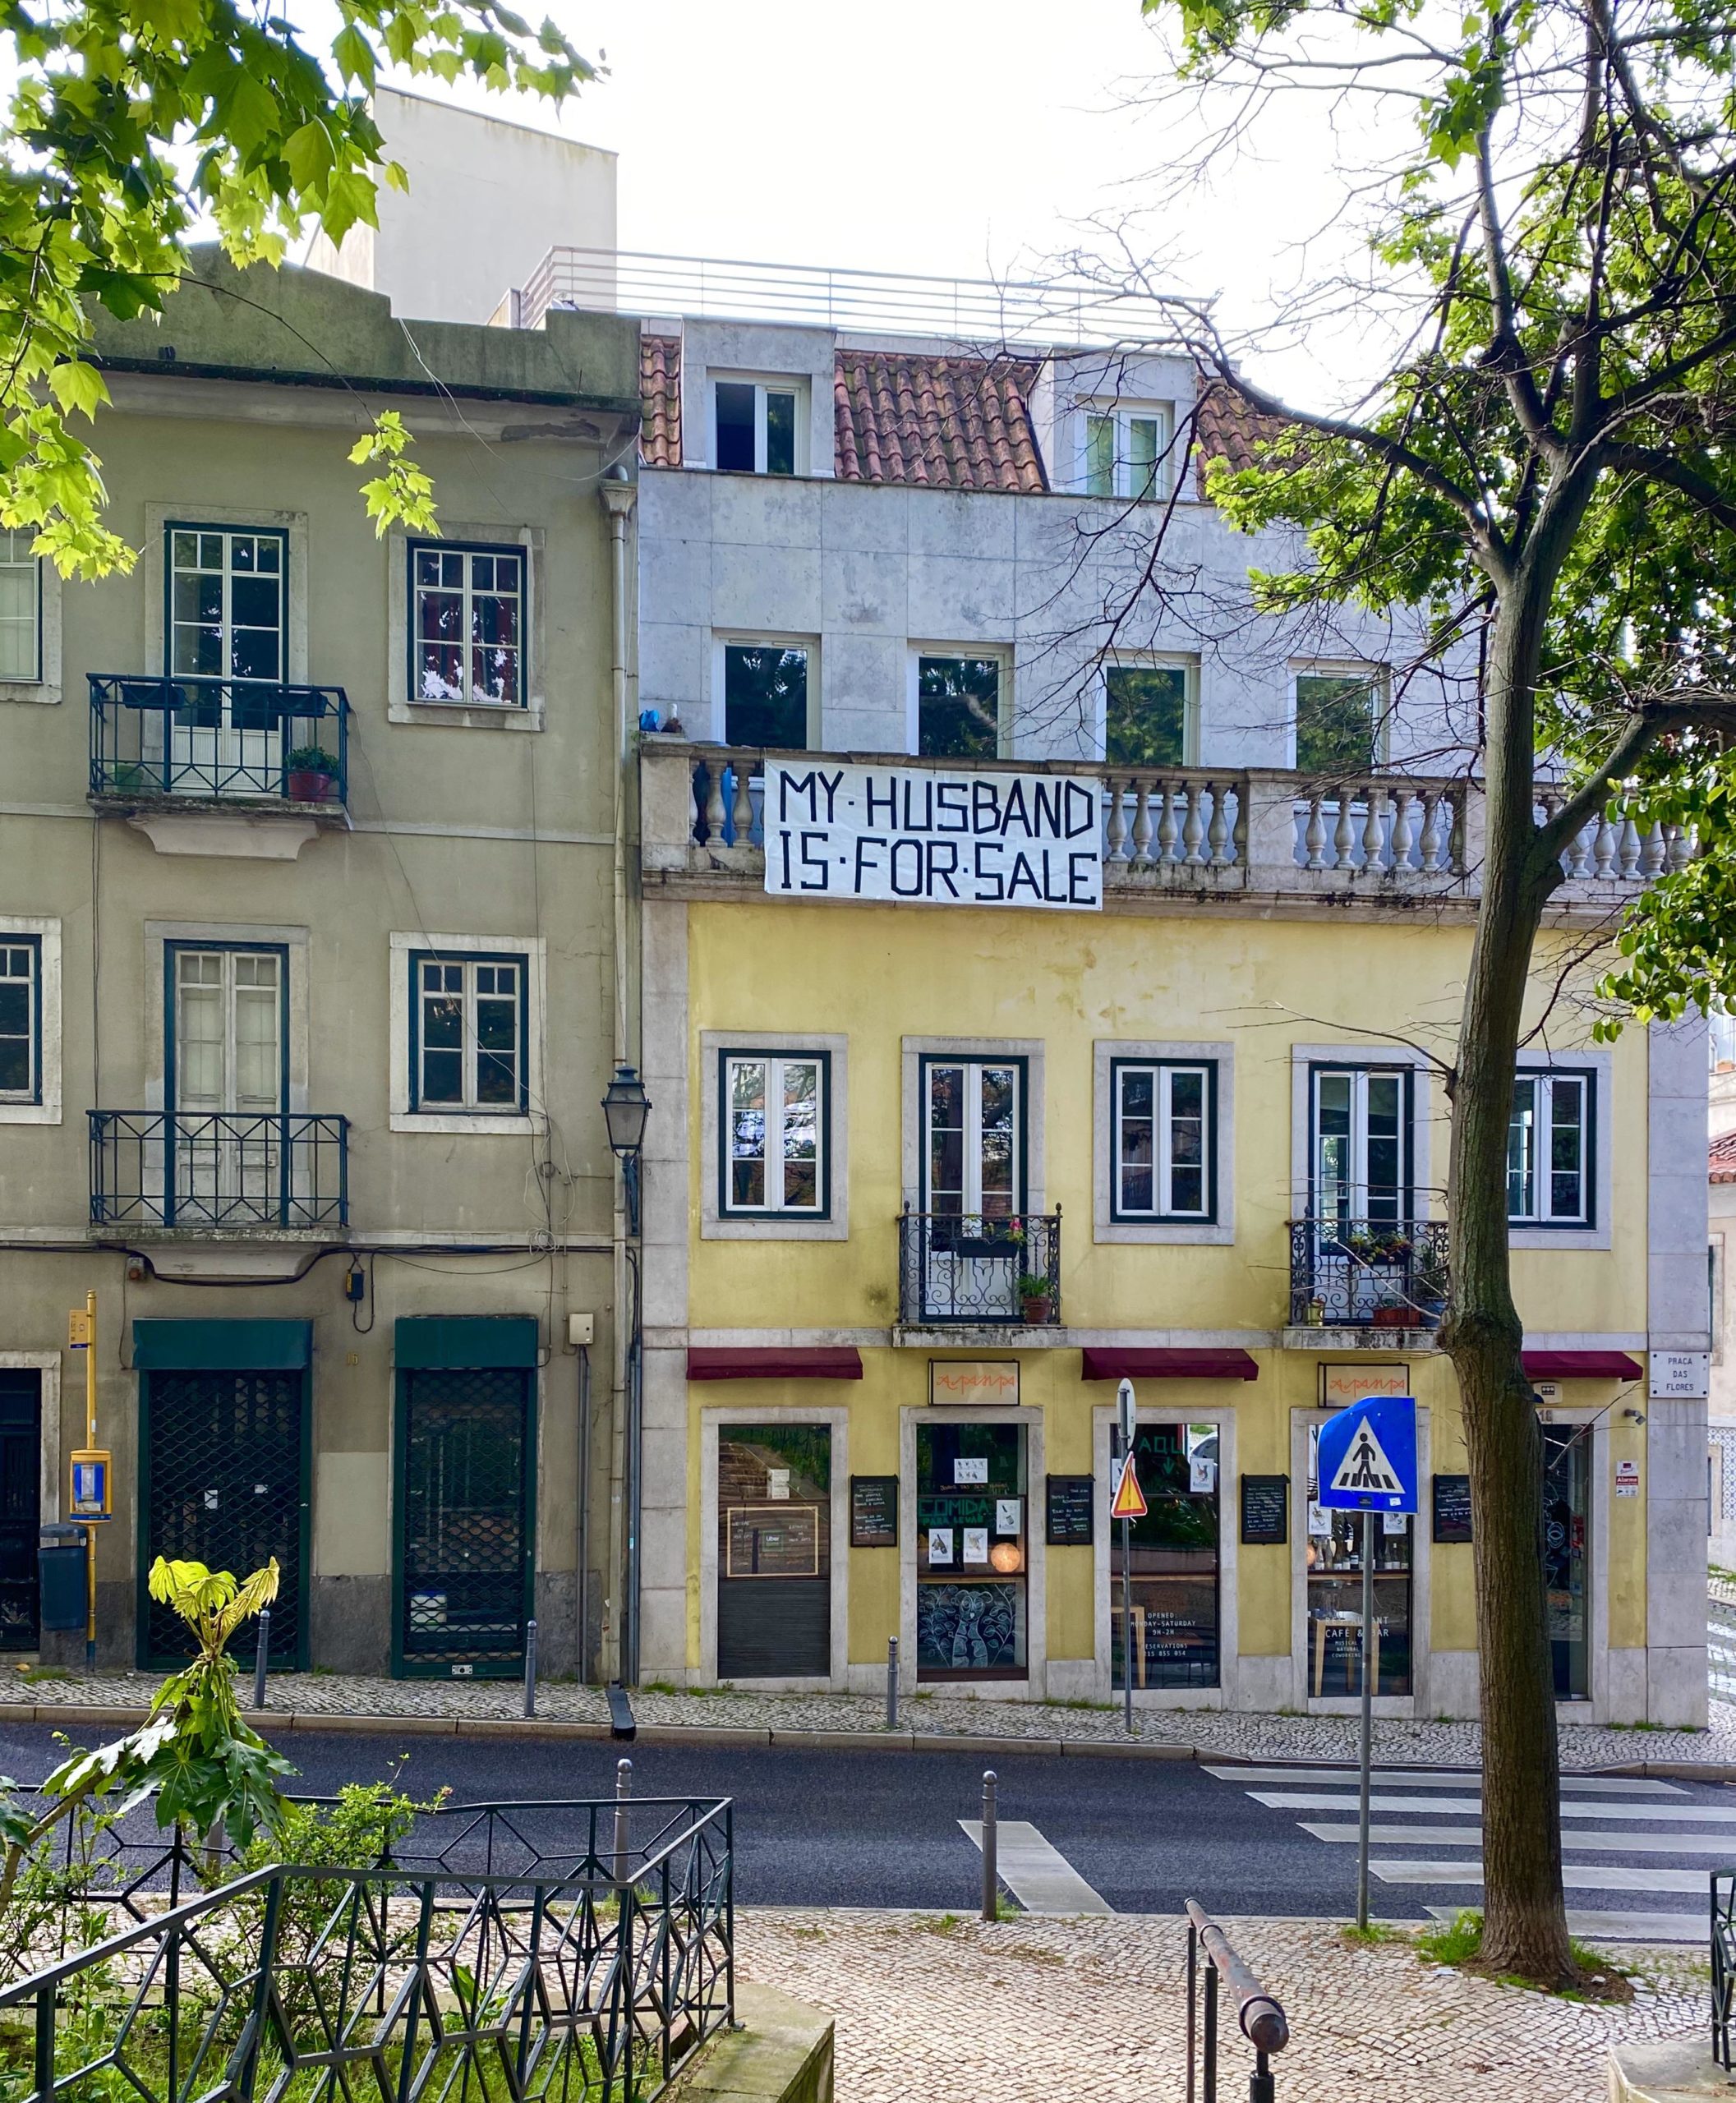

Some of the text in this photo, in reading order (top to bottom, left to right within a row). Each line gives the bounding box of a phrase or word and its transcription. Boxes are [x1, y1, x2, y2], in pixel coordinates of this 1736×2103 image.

[780, 770, 1094, 840] MY HUSBAND
[779, 831, 1098, 904] IS FOR SALE
[919, 1498, 989, 1517] COMIDA
[922, 1516, 949, 1525] PARA
